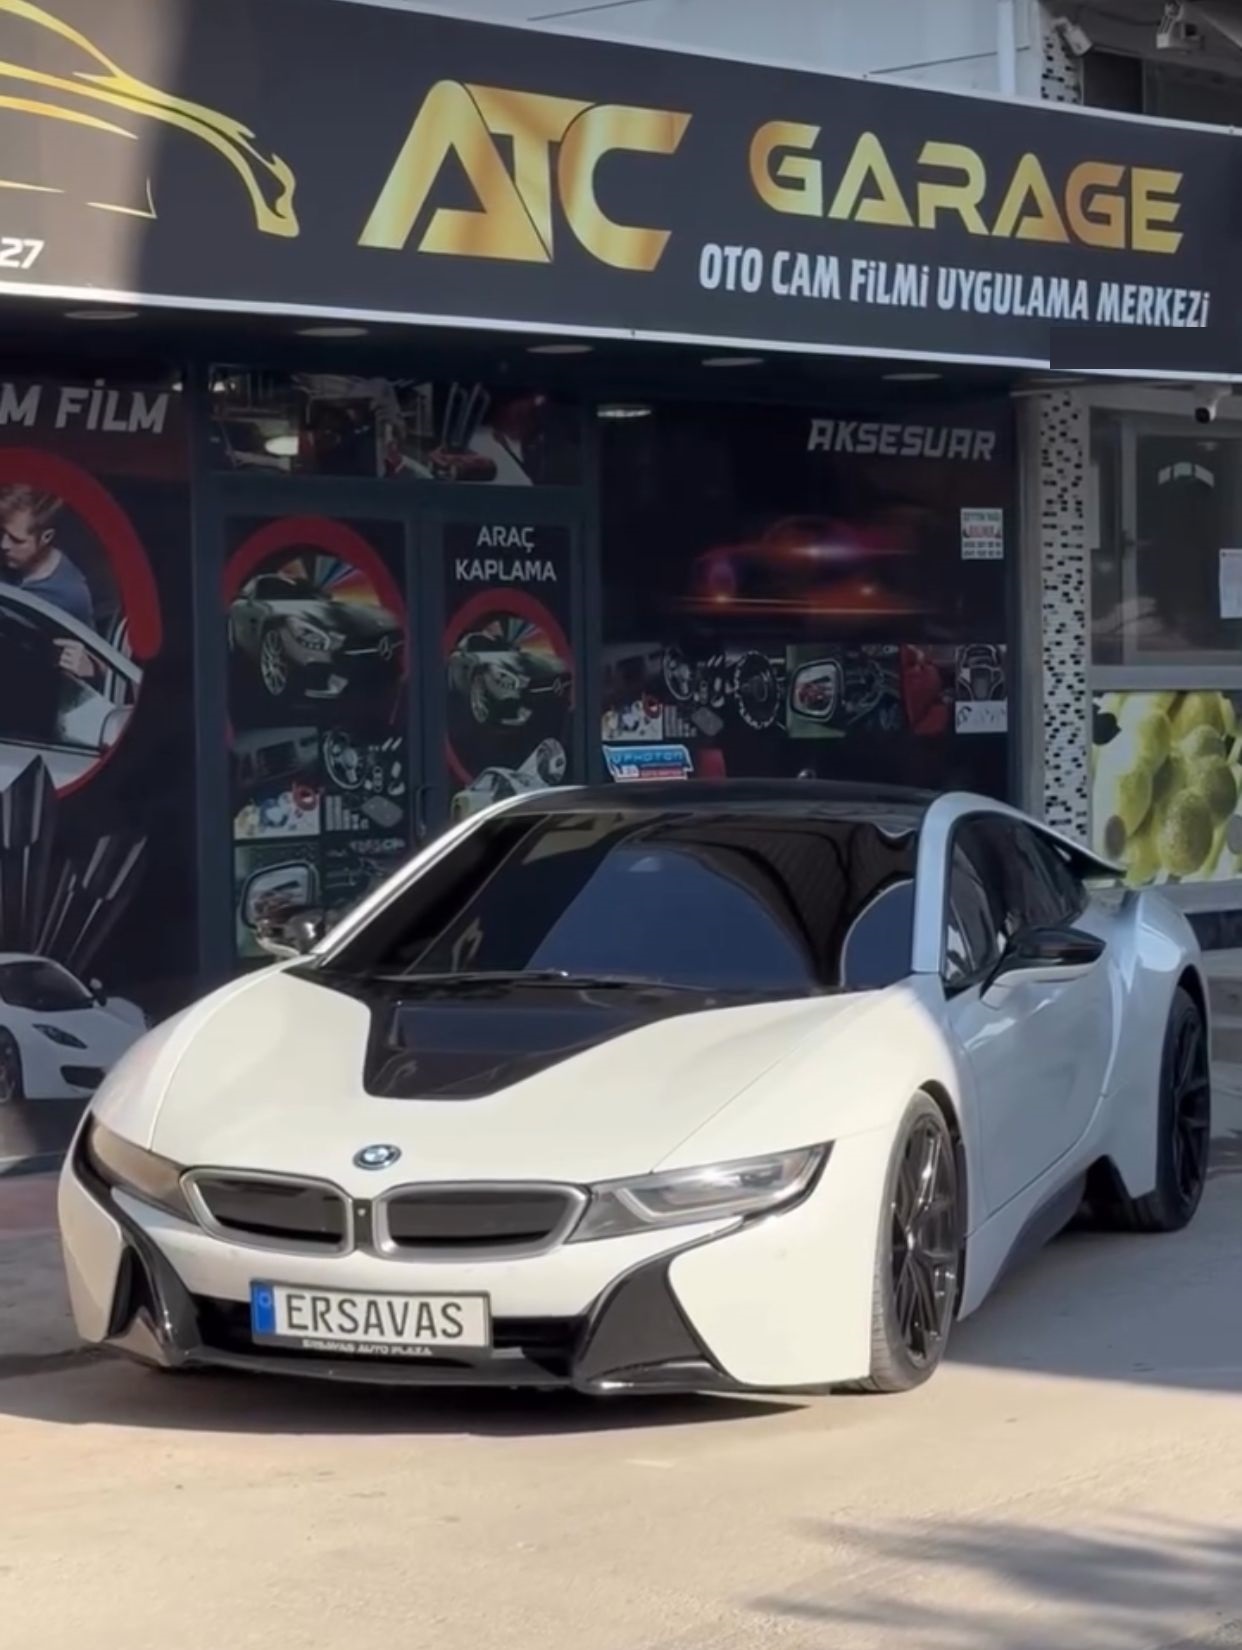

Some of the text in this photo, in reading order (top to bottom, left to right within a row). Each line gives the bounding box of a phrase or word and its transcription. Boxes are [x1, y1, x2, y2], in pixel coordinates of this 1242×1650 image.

[359, 79, 1184, 271] ATC GARAGE
[699, 243, 763, 293] OTO
[771, 250, 842, 300] CAM
[937, 266, 1089, 321] UYGULAMA
[807, 418, 996, 461] AKSESUAR
[455, 525, 558, 582] ARAÇ KAPLAMA
[285, 1292, 464, 1339] ERSAVAS
